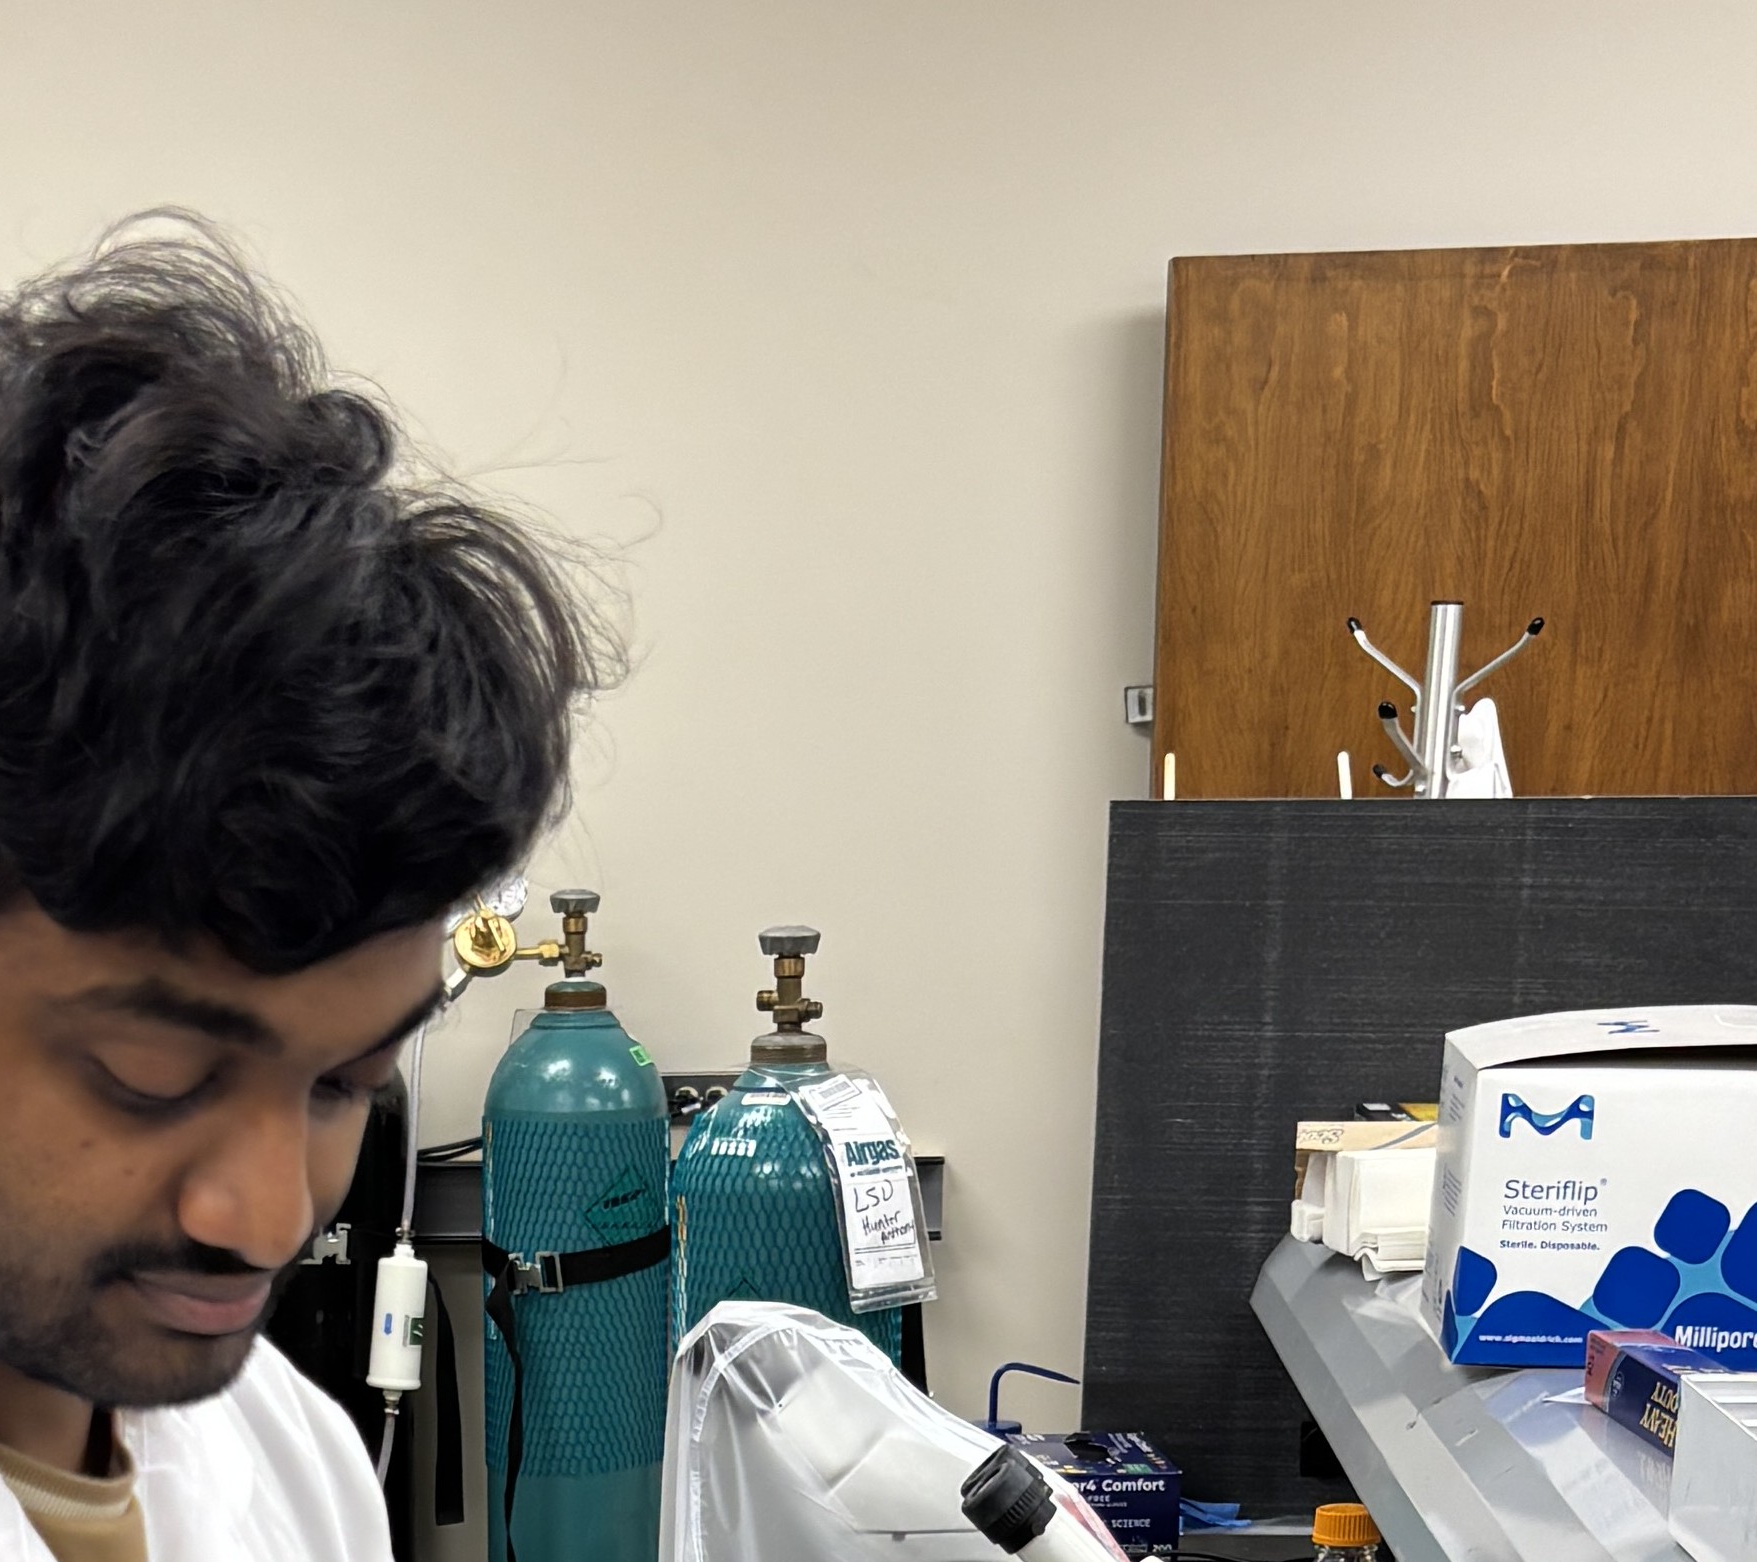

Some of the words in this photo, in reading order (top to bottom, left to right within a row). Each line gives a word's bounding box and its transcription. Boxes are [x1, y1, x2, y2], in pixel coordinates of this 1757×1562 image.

[845, 1138, 902, 1167] Airgas
[1503, 1204, 1598, 1217] Vacuum-driven
[1501, 1219, 1557, 1232] Filtration
[1561, 1219, 1608, 1234] System
[1499, 1239, 1538, 1250] Sterile.
[1540, 1239, 1601, 1252] Disposable.
[1639, 1402, 1679, 1448] HEAVY
[1101, 1478, 1146, 1492] Comfort
